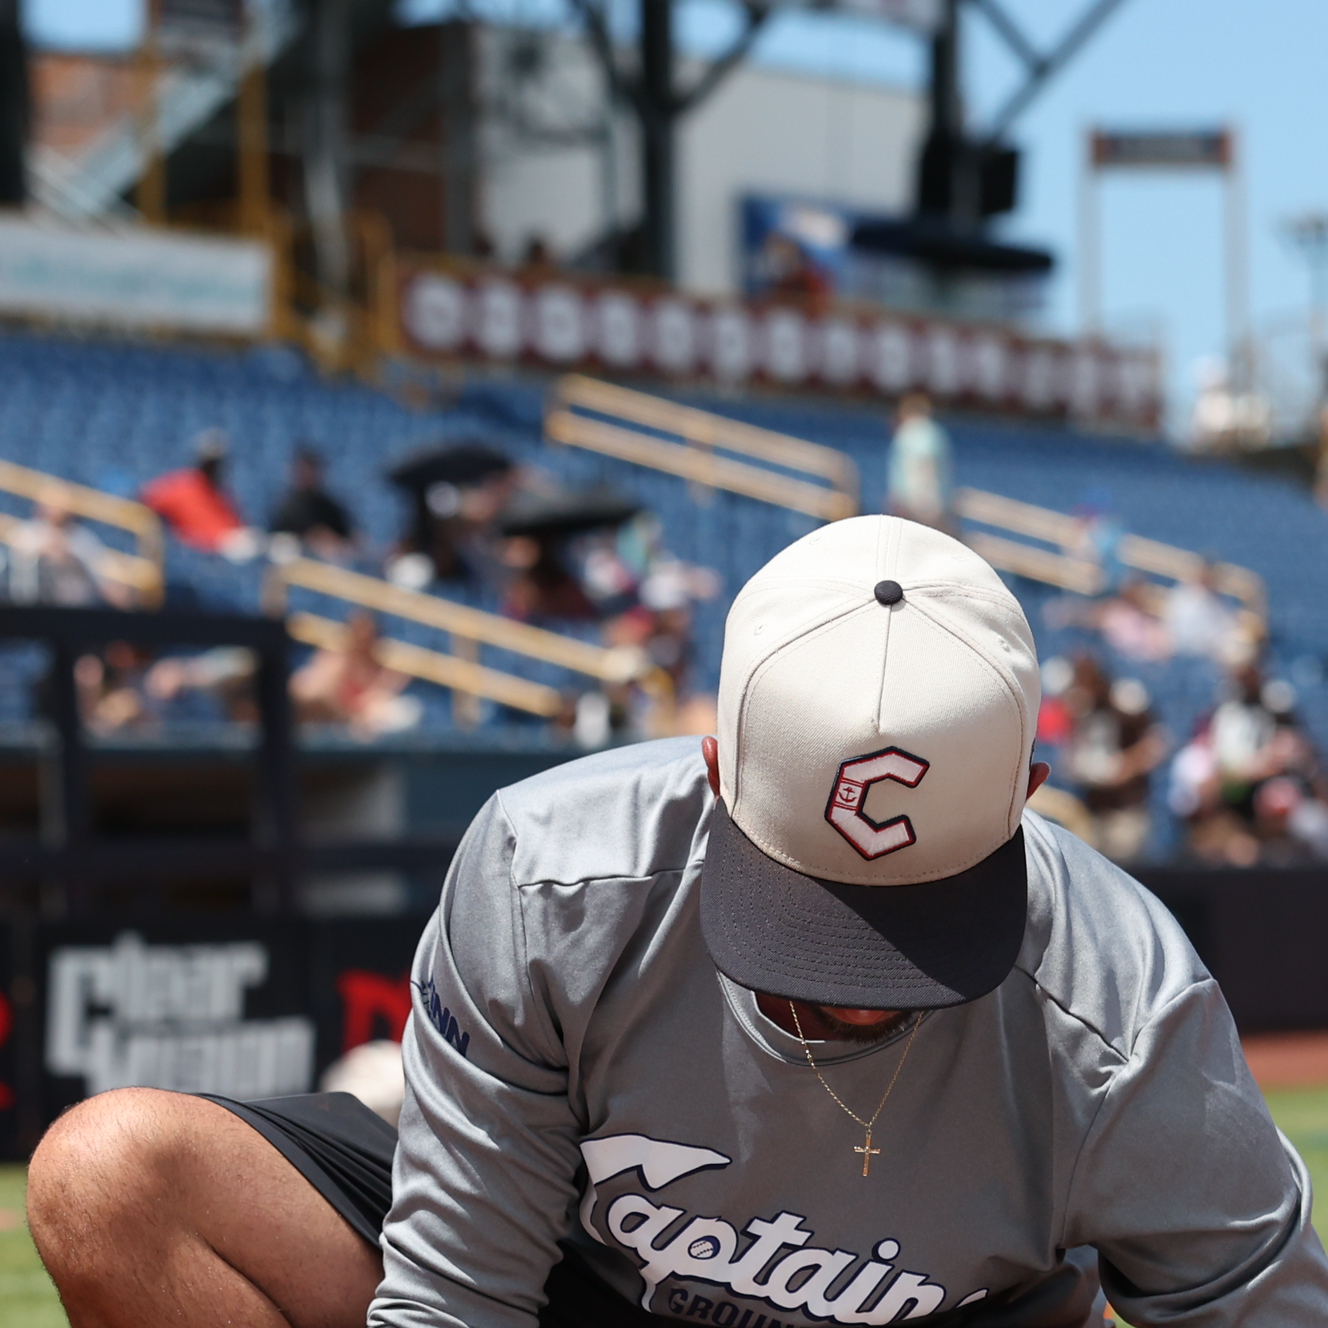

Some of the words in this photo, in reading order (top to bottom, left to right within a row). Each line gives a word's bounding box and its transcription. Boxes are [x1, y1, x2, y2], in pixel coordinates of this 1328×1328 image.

[825, 746, 929, 860] C
[46, 929, 269, 1078] Clear
[579, 1132, 990, 1327] Captain
